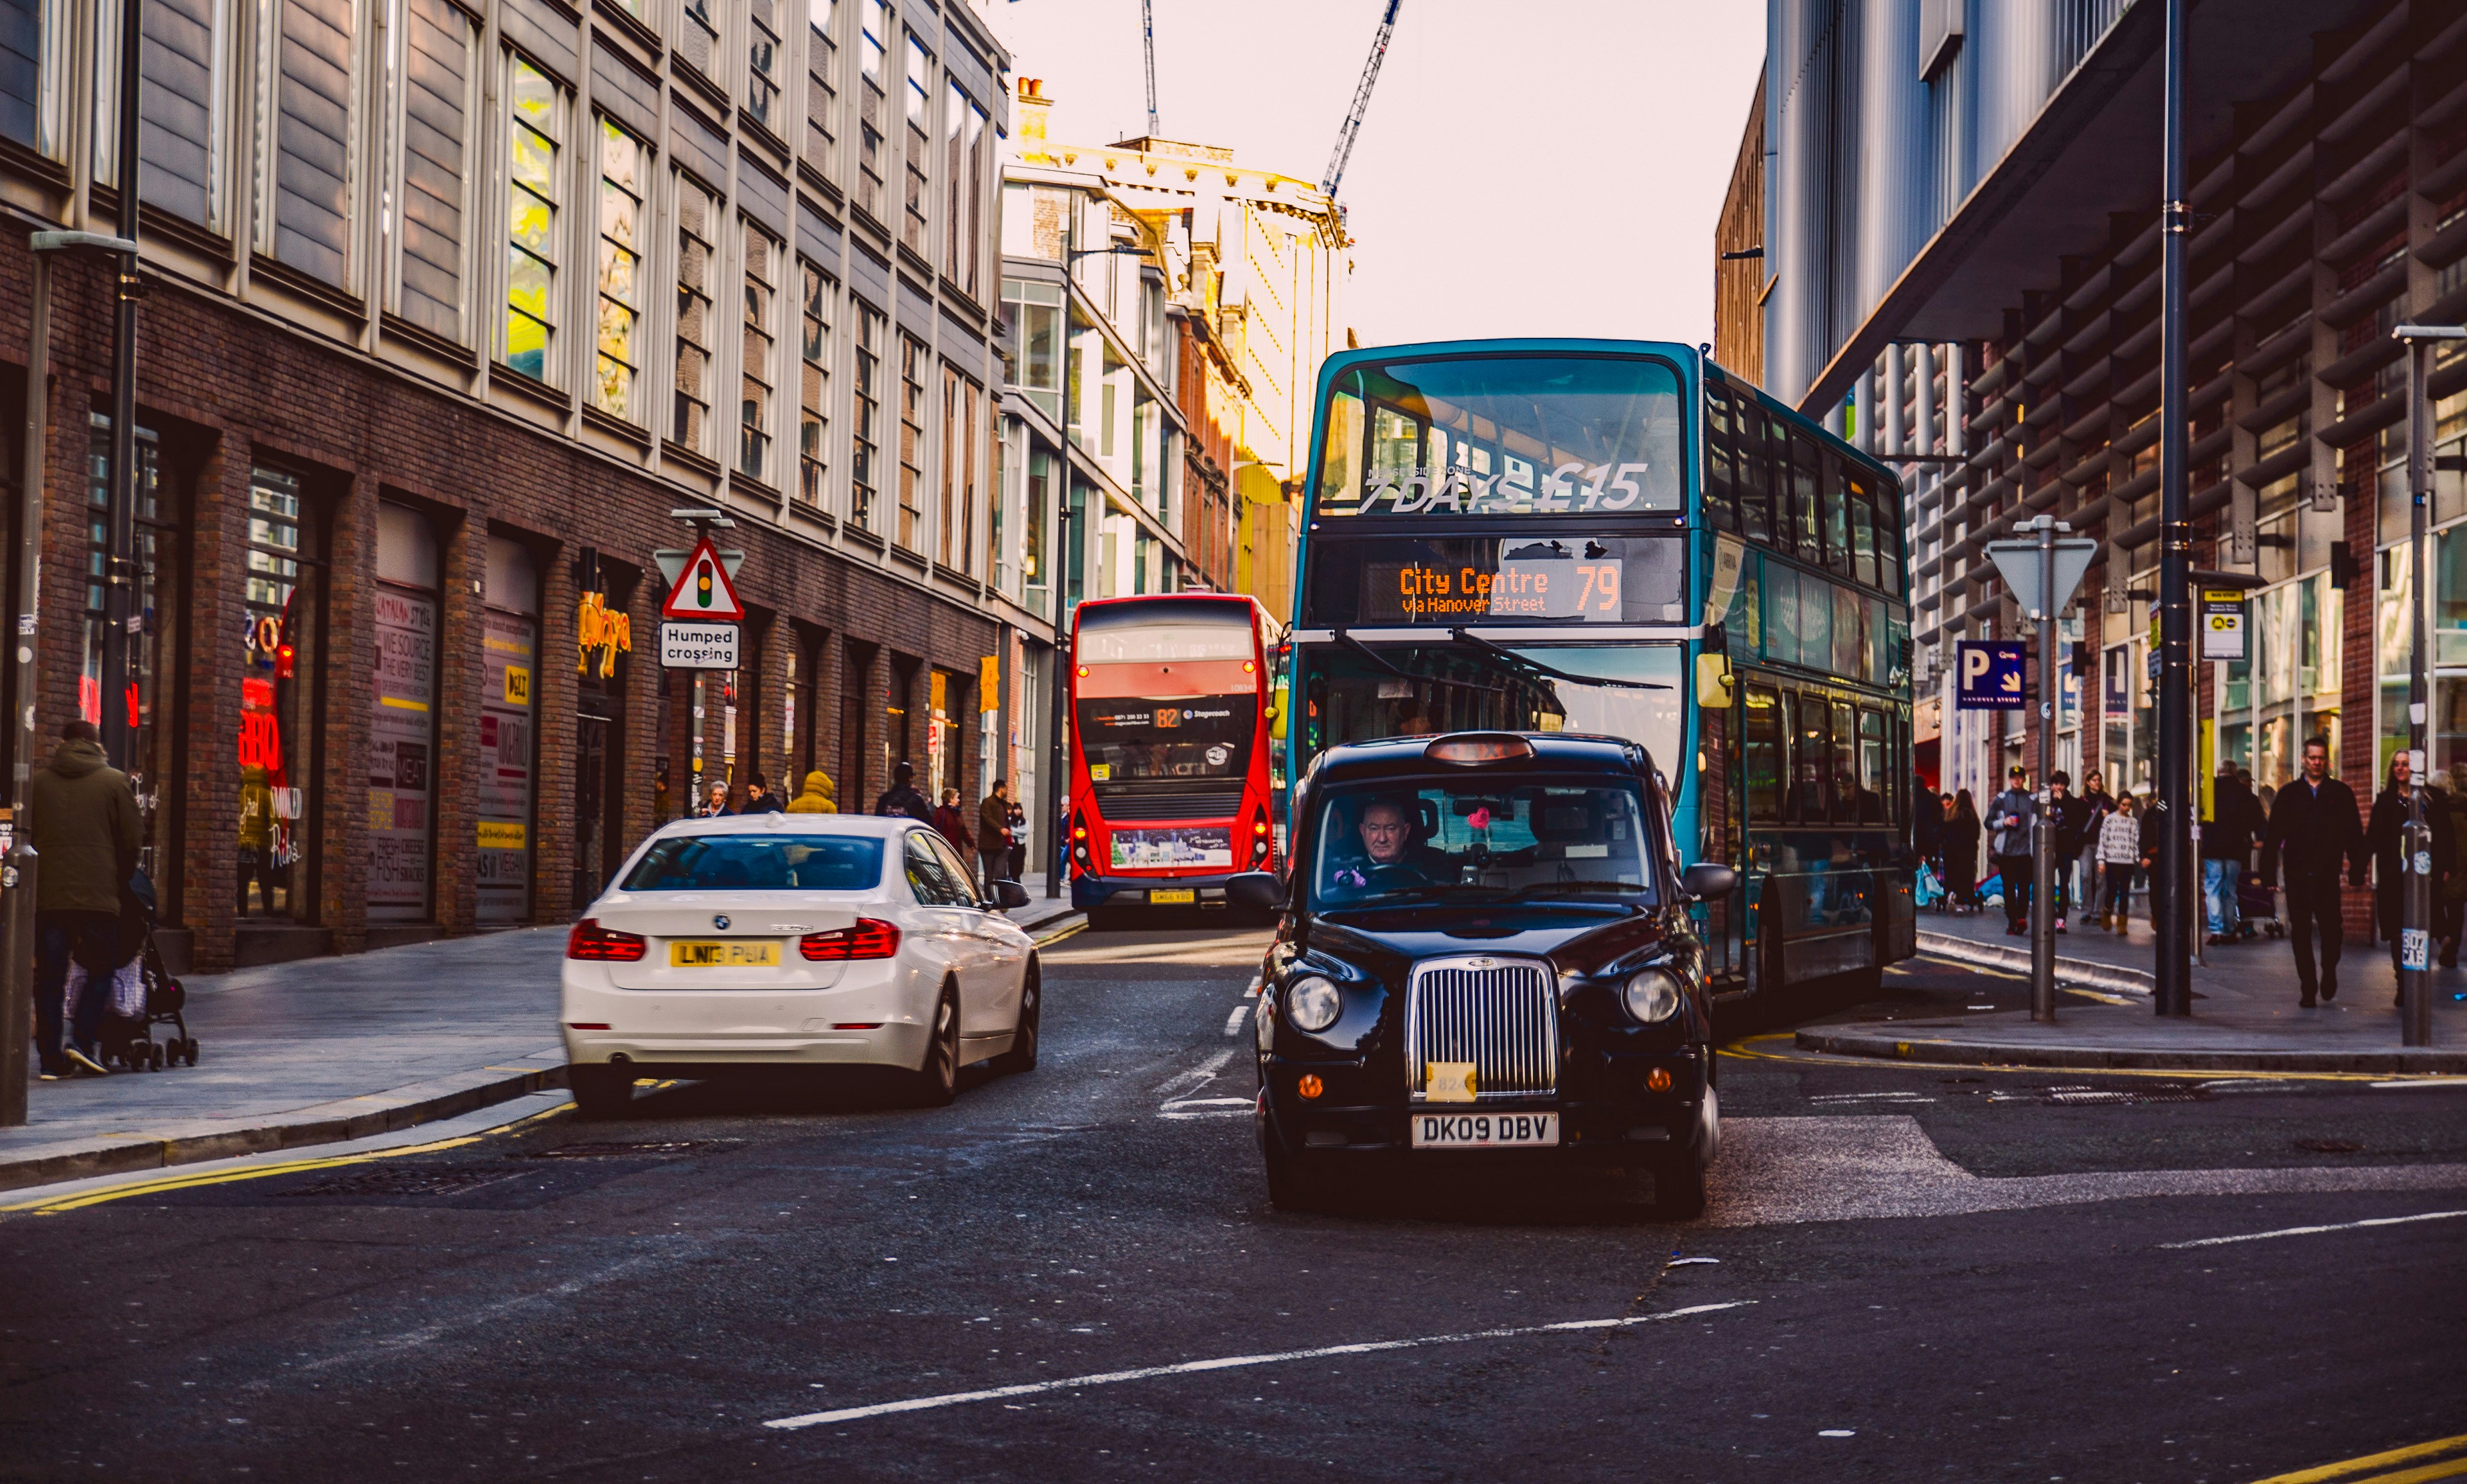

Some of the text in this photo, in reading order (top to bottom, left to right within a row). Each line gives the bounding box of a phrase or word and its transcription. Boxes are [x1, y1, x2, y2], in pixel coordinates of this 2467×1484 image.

[1368, 466, 1471, 477] MERSEYSIDE ZONE
[1357, 463, 1649, 514] 7 DAYS £15
[1401, 567, 1548, 594] City Centre
[1577, 566, 1618, 611] 79
[1402, 597, 1546, 613] via Hanover Street
[398, 634, 430, 661] SOURCE
[668, 629, 732, 644] Humped
[668, 647, 732, 662] crossing
[1963, 649, 1990, 691] P
[1157, 709, 1178, 728] 82
[1194, 710, 1230, 719] Stagecoach
[1451, 743, 1510, 759] TAXI
[398, 758, 426, 784] MEAT
[377, 855, 400, 883] FISH
[1424, 1115, 1548, 1140] DK09 DBV
